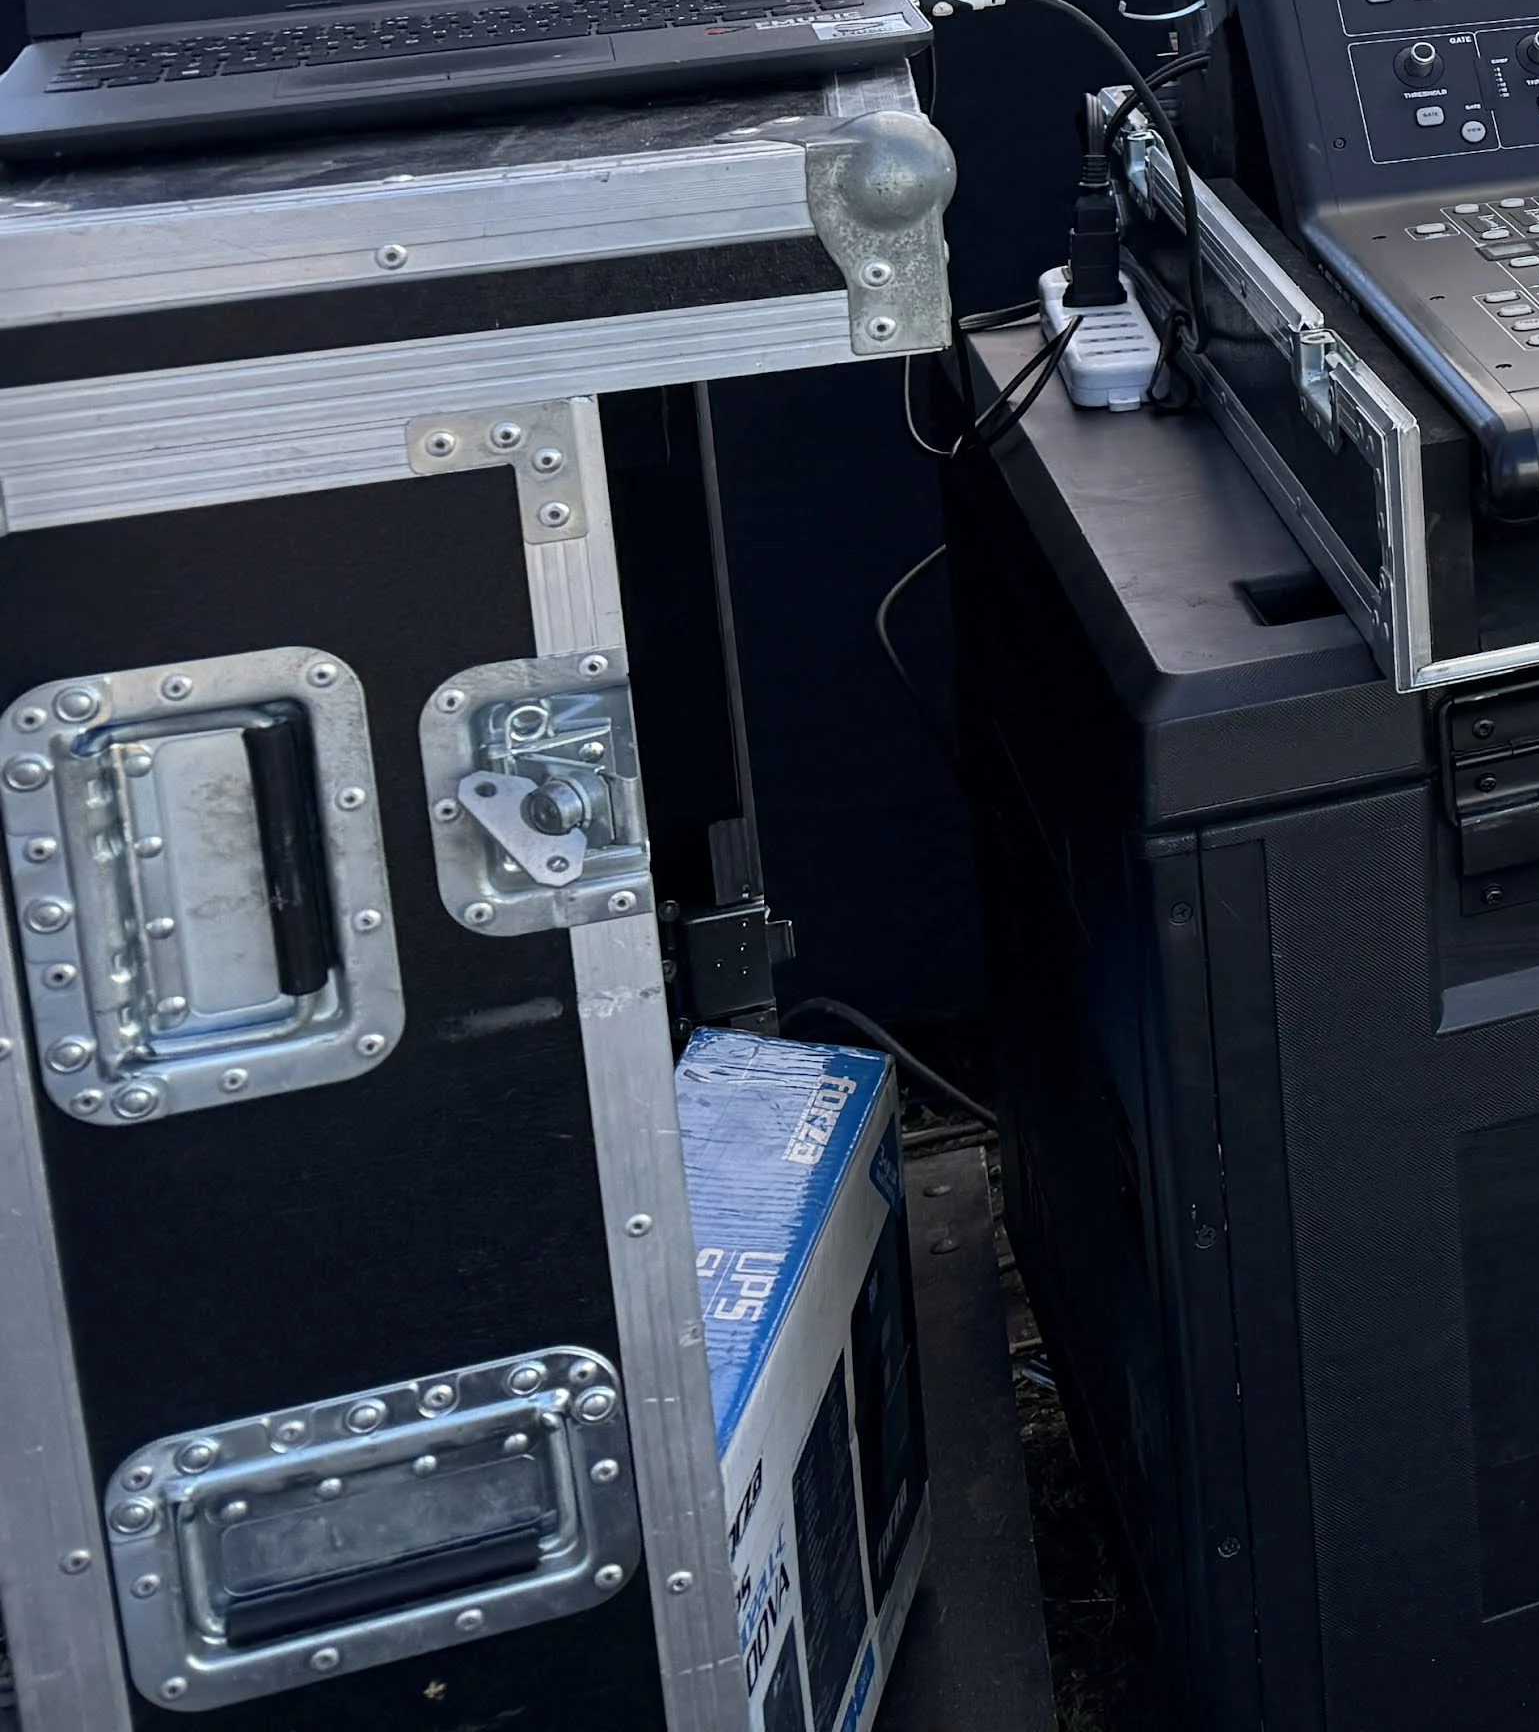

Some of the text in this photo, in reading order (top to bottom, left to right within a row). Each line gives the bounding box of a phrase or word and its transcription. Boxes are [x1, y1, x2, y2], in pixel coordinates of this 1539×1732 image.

[1449, 35, 1471, 44] GATE
[1403, 89, 1447, 99] THRESHOLD
[787, 1074, 857, 1165] forza
[713, 1251, 788, 1322] UPS
